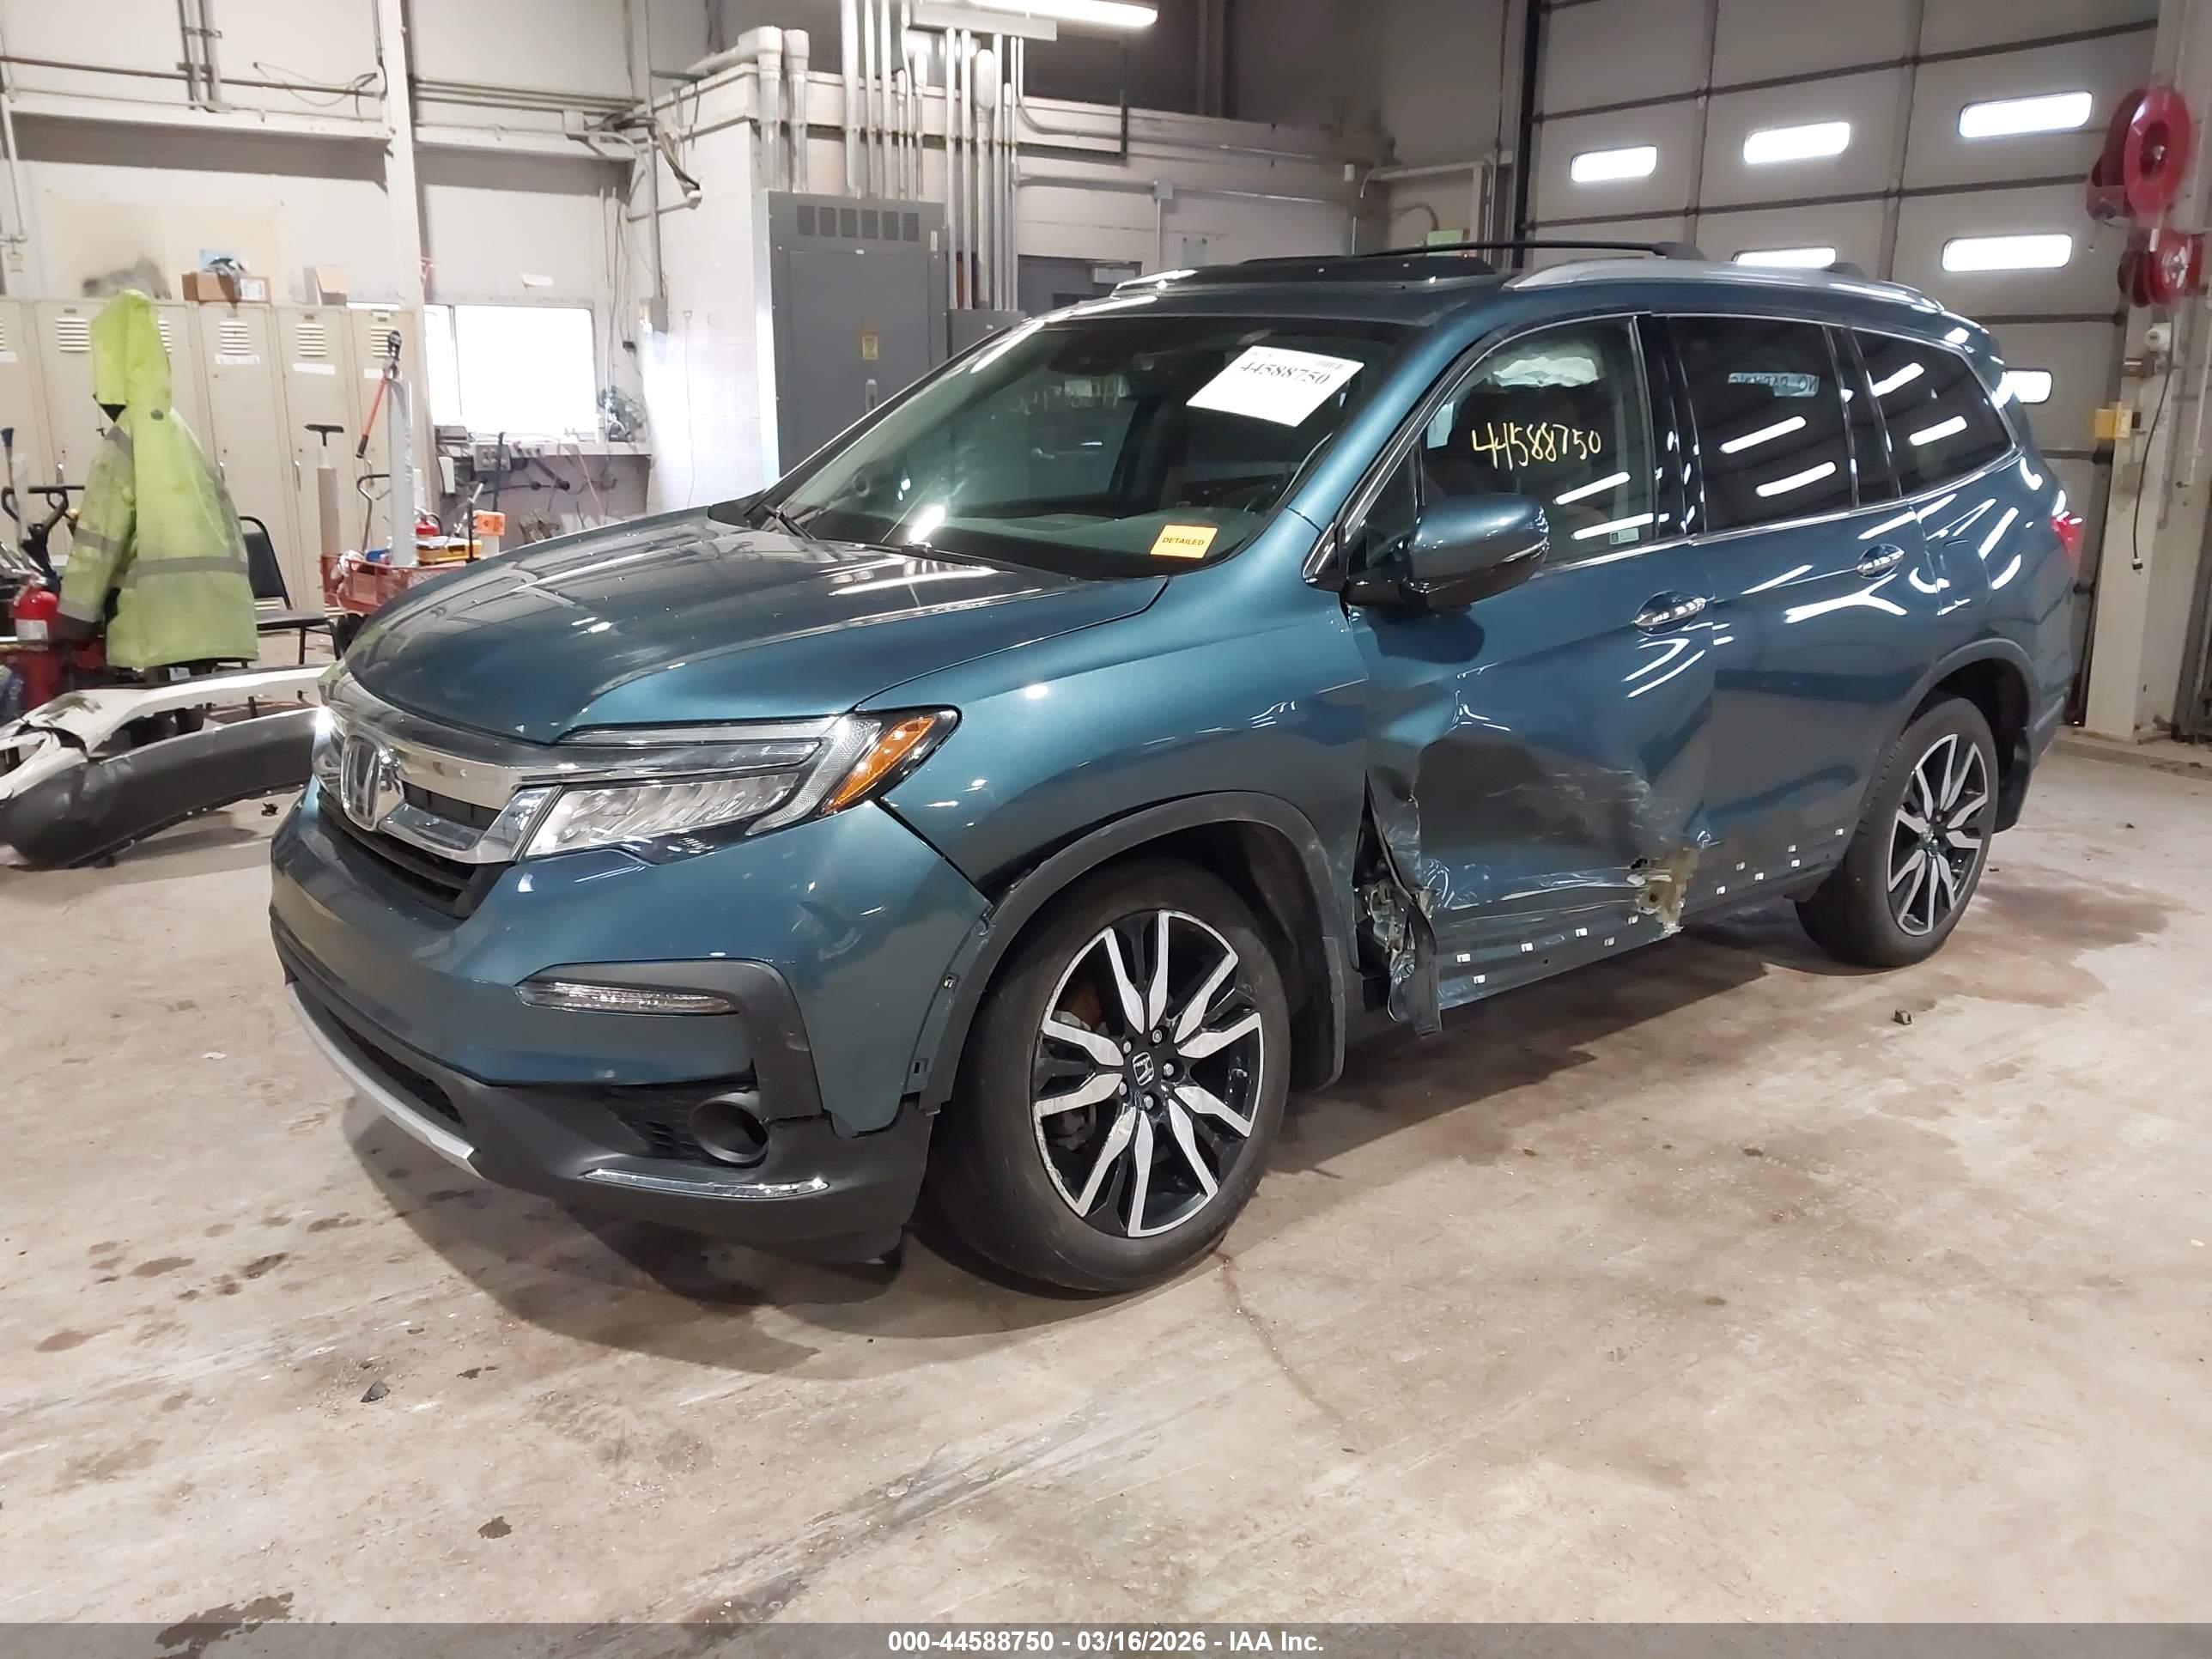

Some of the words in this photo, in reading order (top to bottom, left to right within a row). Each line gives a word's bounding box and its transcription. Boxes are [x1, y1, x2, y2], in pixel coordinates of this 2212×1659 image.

[1240, 361, 1331, 385] 44588750
[1471, 422, 1602, 471] 44588750
[1162, 537, 1205, 546] DETAILED
